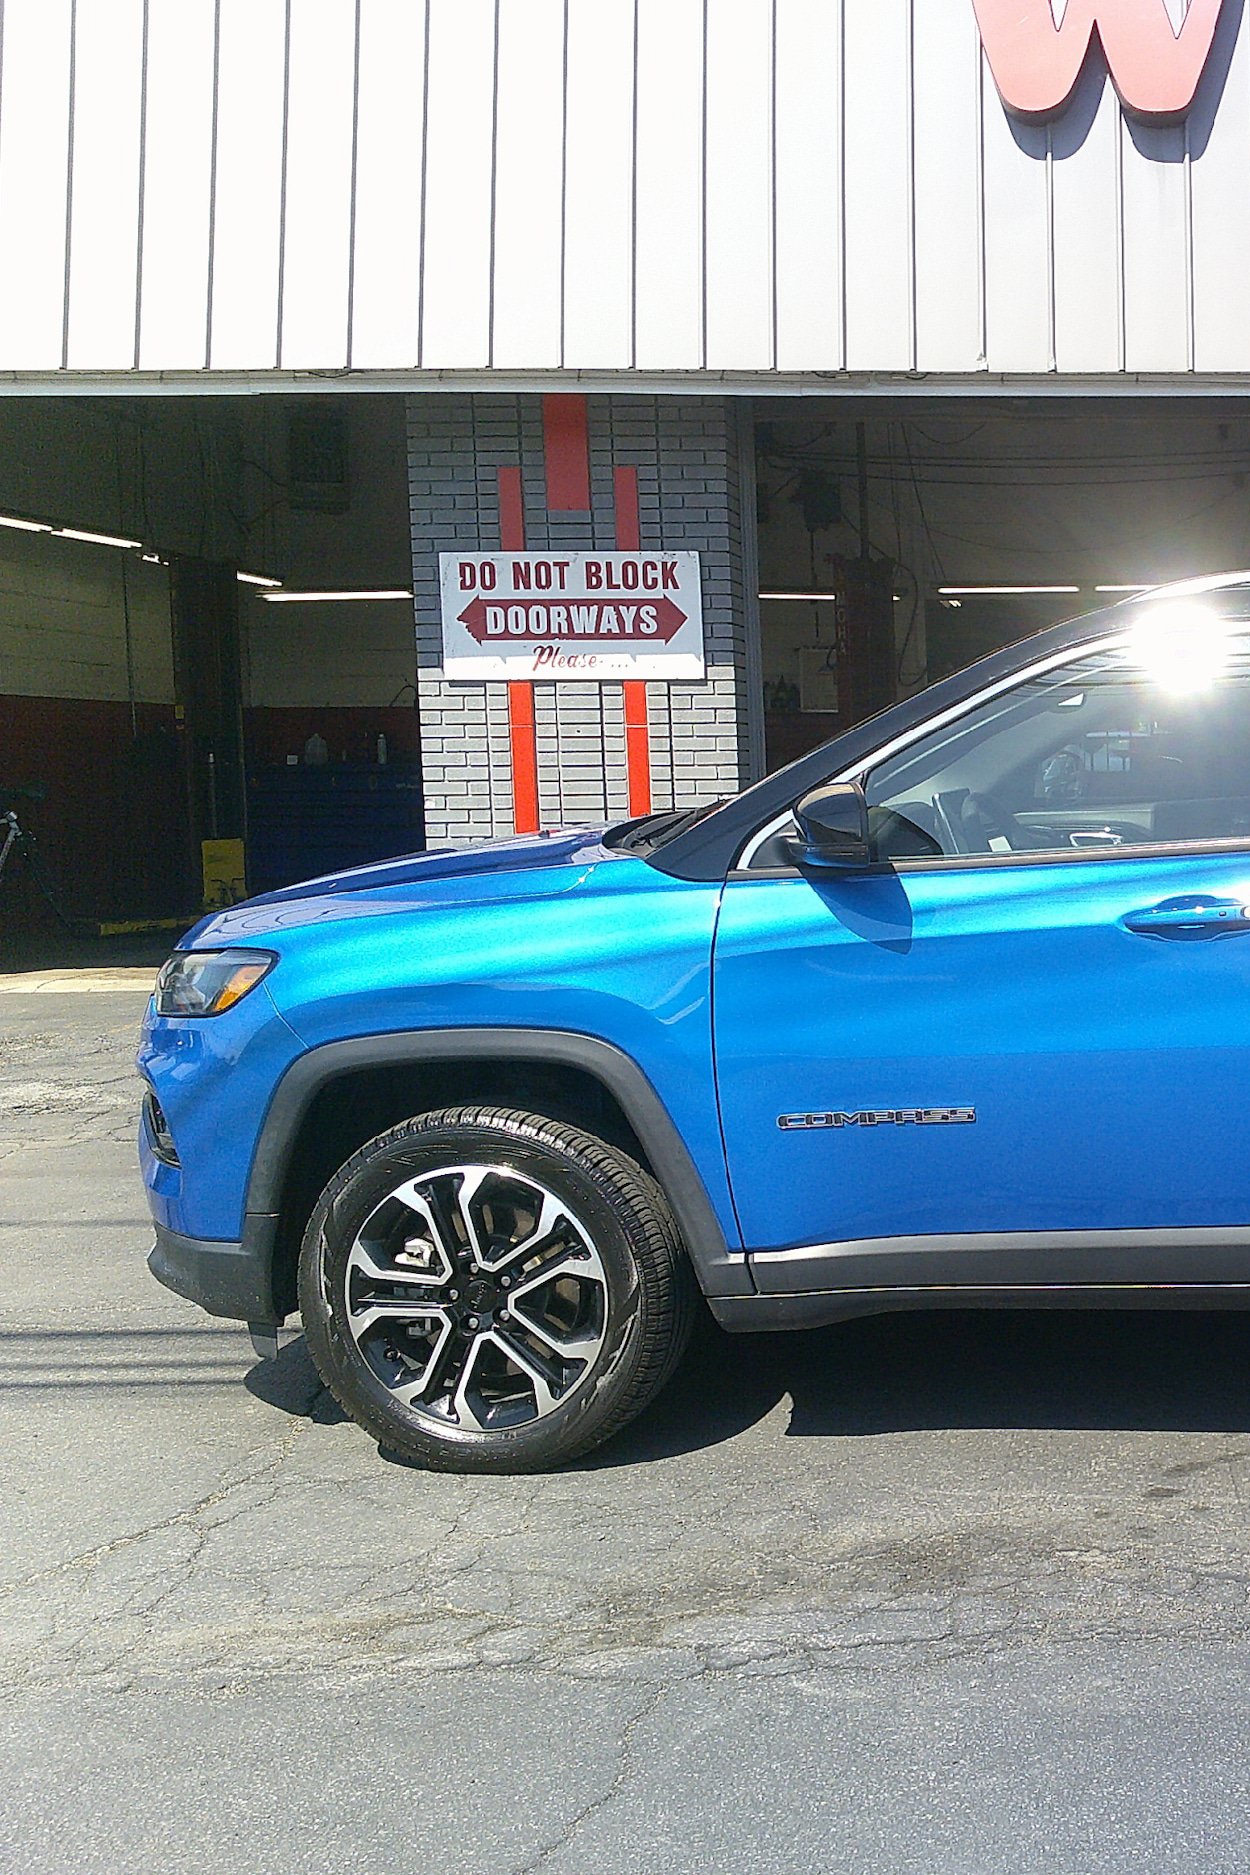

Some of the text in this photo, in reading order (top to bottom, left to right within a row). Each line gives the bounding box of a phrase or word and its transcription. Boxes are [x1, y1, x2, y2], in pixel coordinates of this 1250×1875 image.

[458, 560, 681, 590] DO NOT BLOCK
[486, 605, 658, 635] DOORWAYS
[776, 1107, 977, 1129] COMPASS
